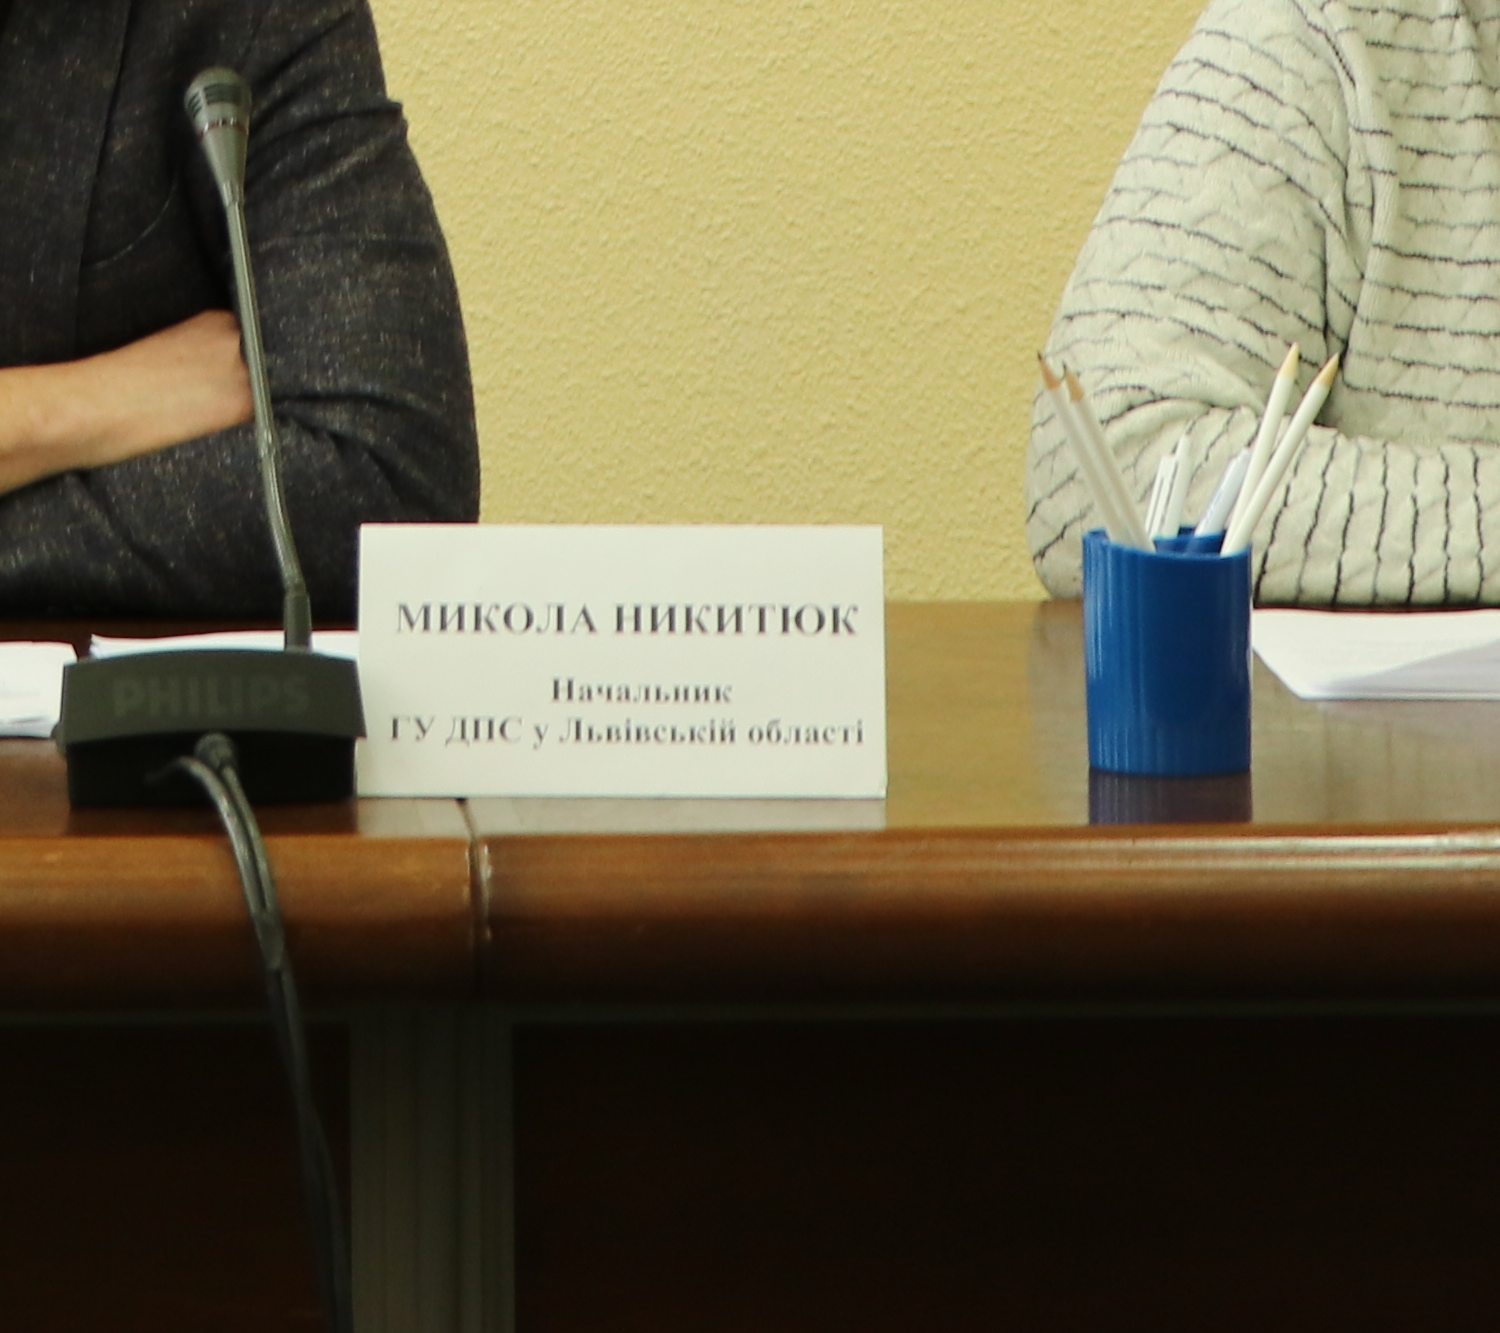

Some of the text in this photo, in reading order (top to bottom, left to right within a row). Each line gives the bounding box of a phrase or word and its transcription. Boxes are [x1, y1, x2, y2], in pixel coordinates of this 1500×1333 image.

[396, 602, 860, 636] МИКОЛА НИКИТЮК
[112, 674, 311, 718] PHILIPS
[550, 677, 734, 704] Начальник
[388, 715, 865, 751] ГУ ДПС у Львівській області
